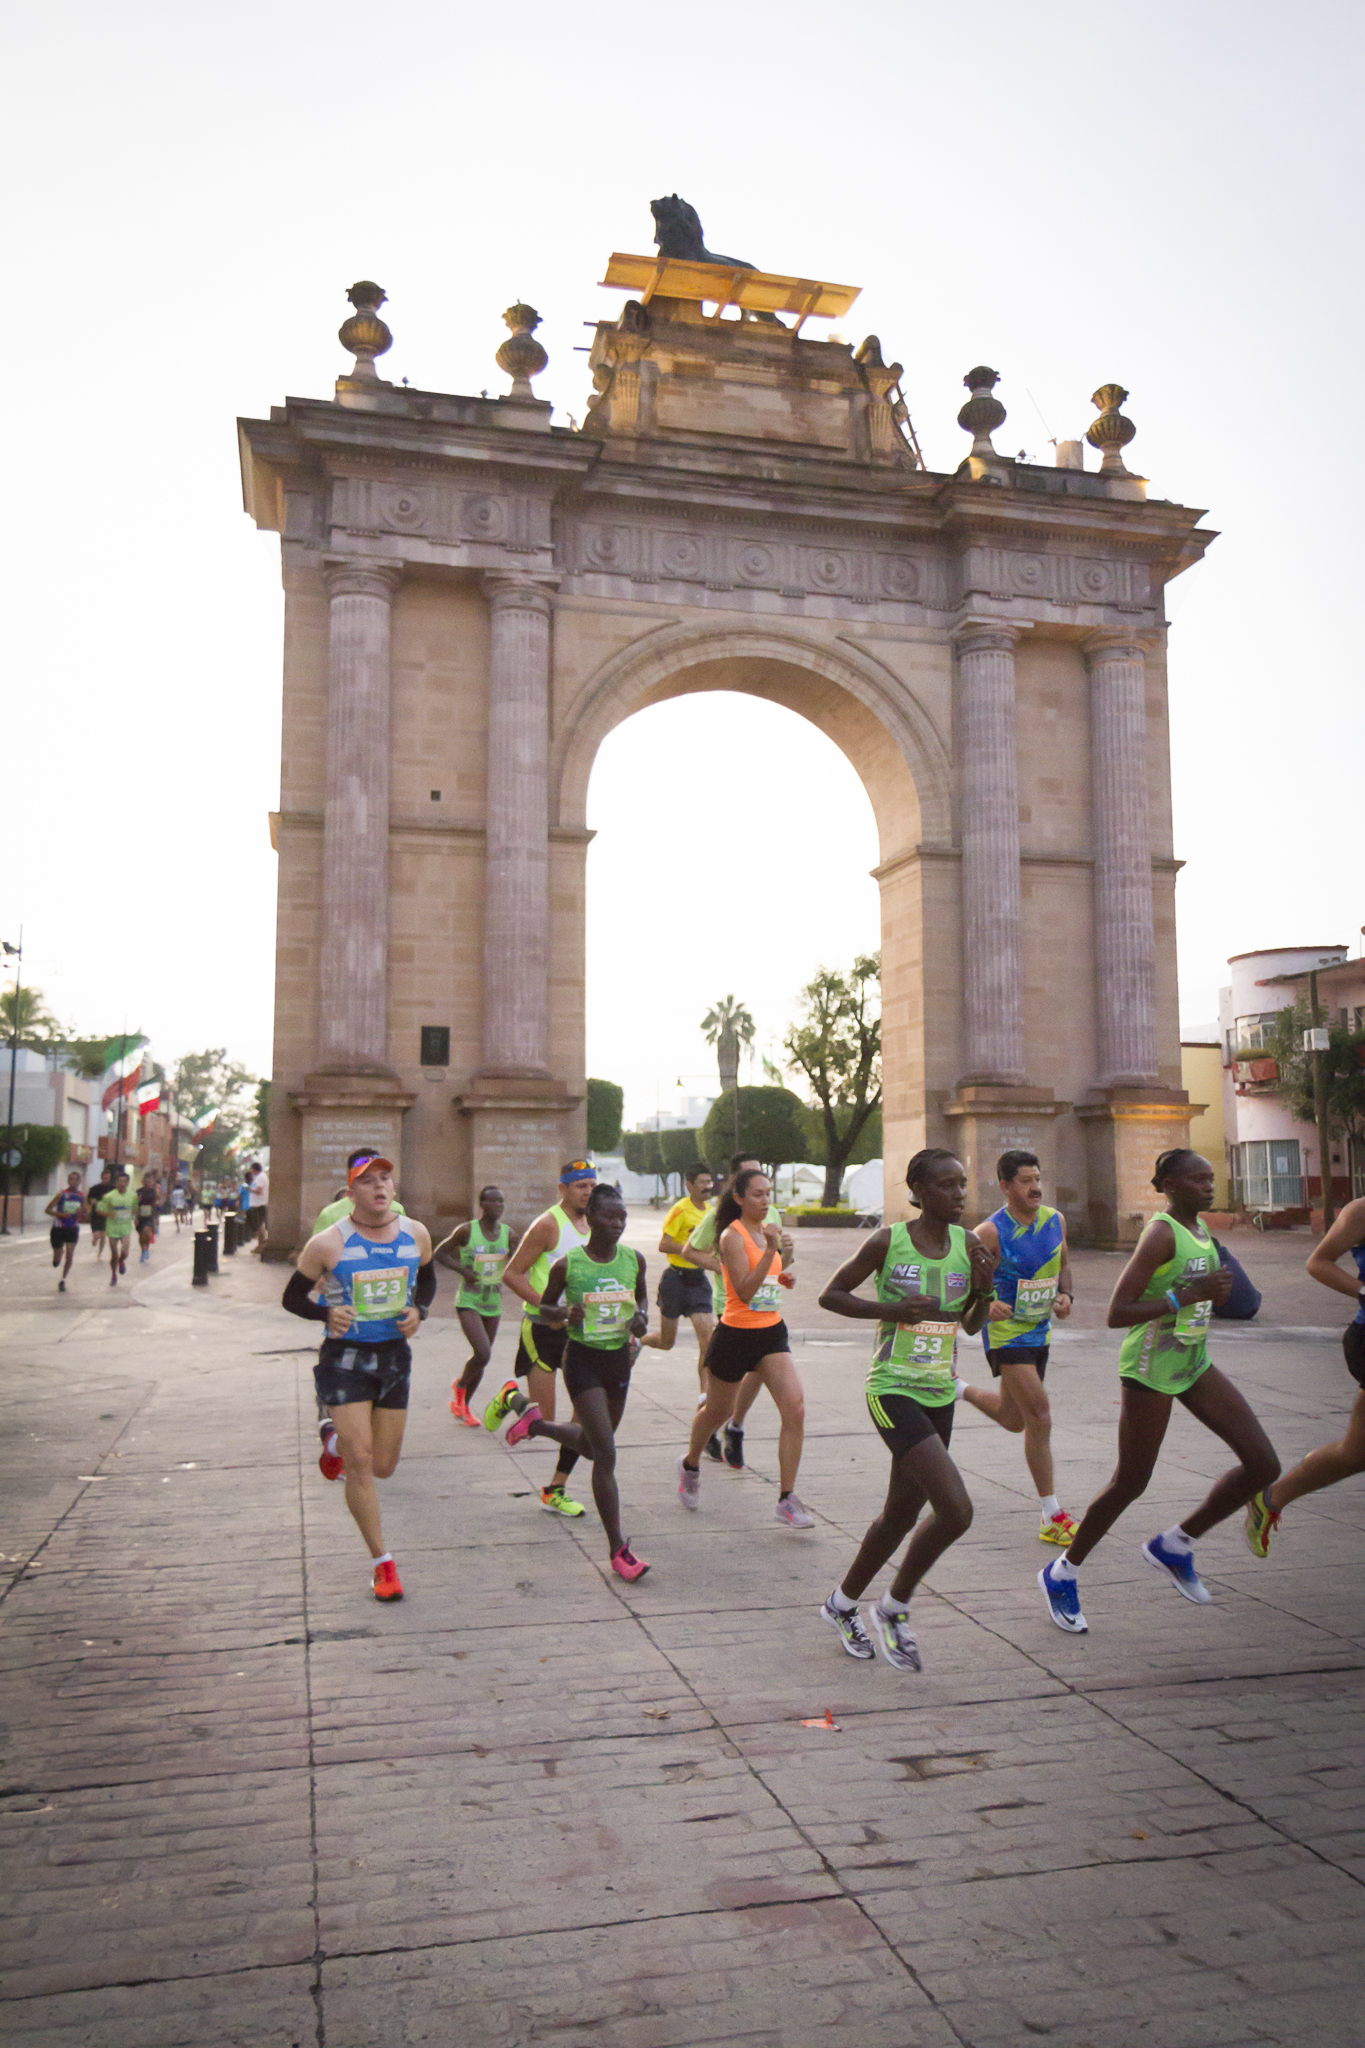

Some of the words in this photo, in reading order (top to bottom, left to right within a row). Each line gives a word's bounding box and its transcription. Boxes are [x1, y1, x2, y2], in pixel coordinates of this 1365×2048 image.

[892, 1264, 921, 1278] NE
[1187, 1258, 1206, 1272] NE
[363, 1280, 401, 1297] 123
[1018, 1286, 1056, 1303] 4041
[599, 1303, 622, 1317] 57
[1194, 1300, 1213, 1317] 52
[913, 1335, 943, 1354] 53
